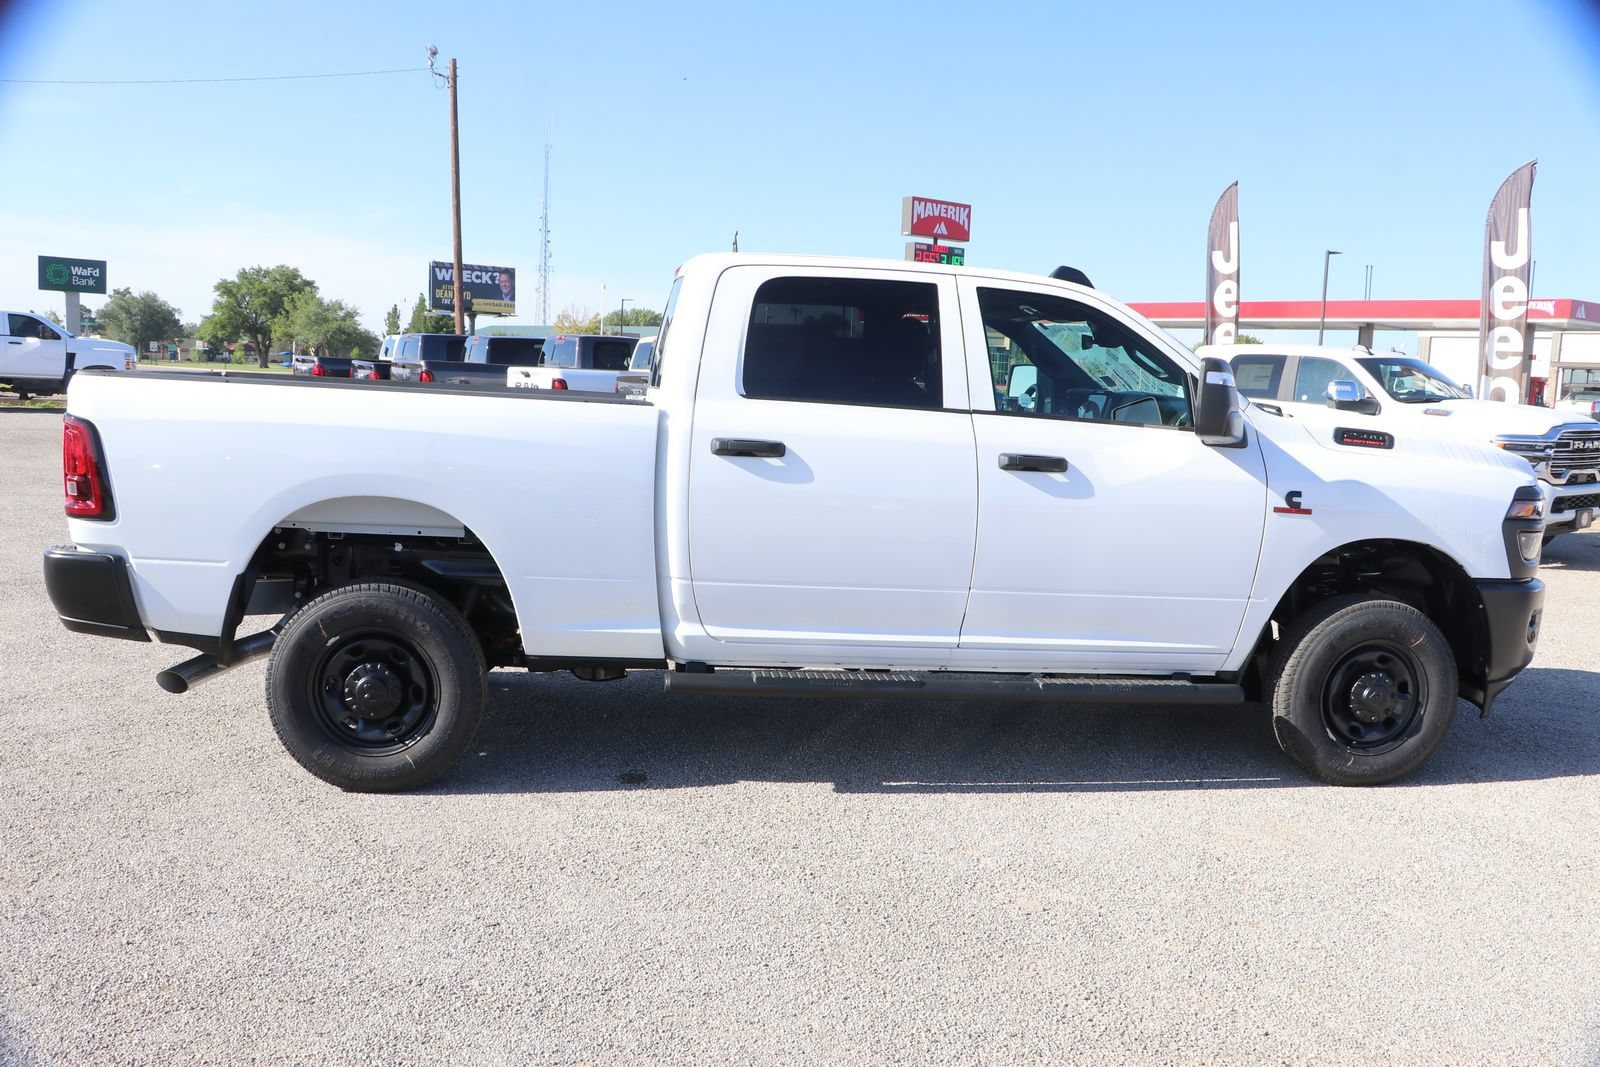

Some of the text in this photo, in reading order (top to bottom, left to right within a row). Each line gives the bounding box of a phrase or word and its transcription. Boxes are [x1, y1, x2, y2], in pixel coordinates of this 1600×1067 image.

[913, 200, 969, 232] MAVERIK
[71, 266, 100, 277] WaFd
[435, 268, 500, 284] WECK?
[72, 276, 96, 286] Bank
[1212, 221, 1239, 345] Jee
[436, 289, 453, 299] DEAN
